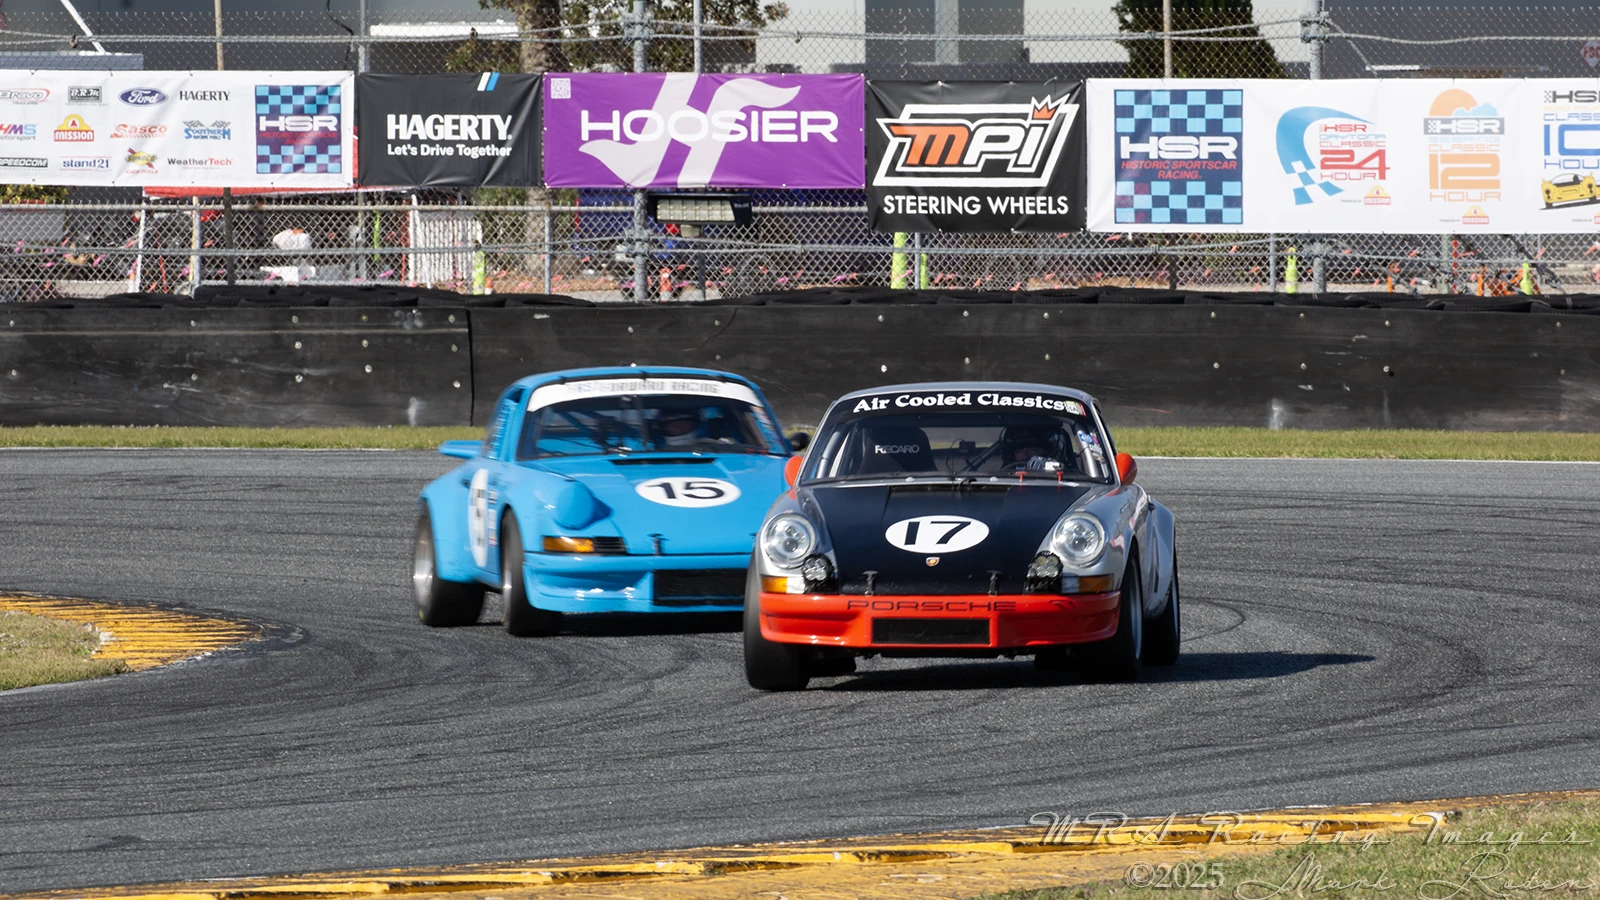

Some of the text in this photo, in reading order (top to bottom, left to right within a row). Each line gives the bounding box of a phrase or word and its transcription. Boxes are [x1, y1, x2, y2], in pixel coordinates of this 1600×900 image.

[128, 90, 159, 104] Ford
[179, 90, 231, 101] HAGERTY
[1552, 90, 1600, 103] HS
[259, 115, 338, 132] HSR
[580, 109, 839, 143] HOOSIER
[1324, 124, 1368, 132] HSR
[1435, 119, 1501, 133] HSR
[55, 131, 93, 140] MISSION
[387, 143, 512, 159] Let's Drive Together
[1120, 136, 1238, 159] HSR
[1428, 144, 1500, 152] CLASSIC
[0, 158, 47, 167] PEEDCOM
[167, 157, 233, 166] WeatherTech
[1121, 160, 1237, 170] HISTORIC SPORTSCAR
[1320, 149, 1391, 180] 24
[1320, 172, 1376, 180] HOUR
[1429, 153, 1501, 190] 12
[1429, 191, 1501, 202] HOUR
[883, 195, 1069, 215] STEERING WHEELS
[853, 398, 889, 413] Air
[895, 393, 971, 408] Cooled
[977, 393, 1065, 411] Classics
[875, 444, 920, 454] RECARO
[644, 482, 725, 499] 15
[904, 521, 972, 545] 17
[847, 600, 1017, 612] PORSCHE
